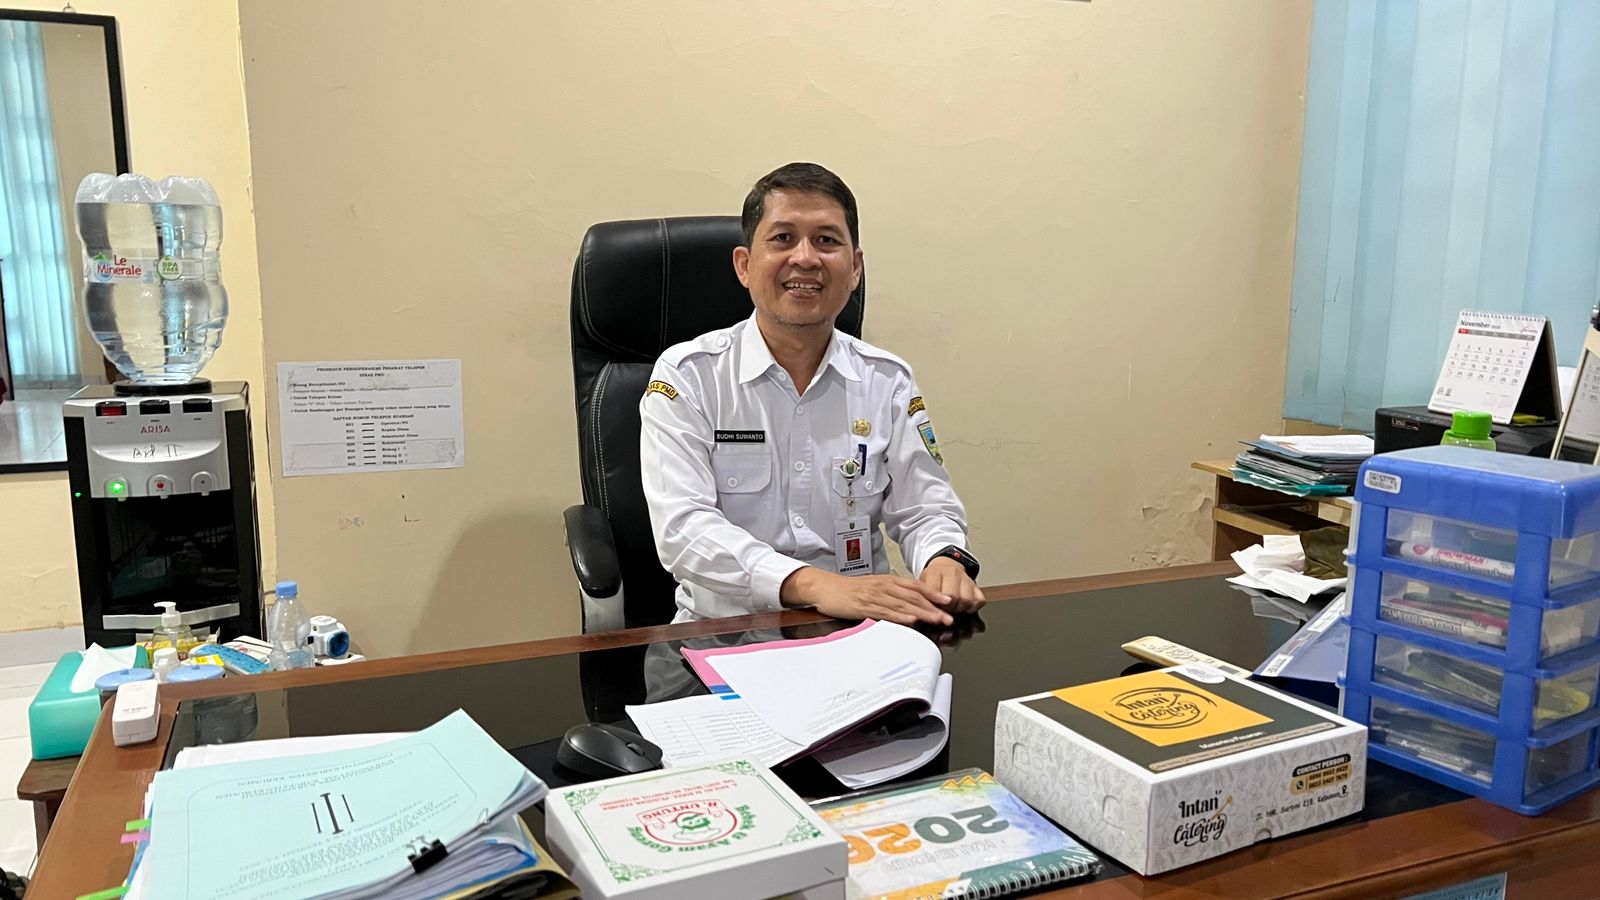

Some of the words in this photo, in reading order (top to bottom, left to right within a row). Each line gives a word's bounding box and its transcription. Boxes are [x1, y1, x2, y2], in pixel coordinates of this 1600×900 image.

[113, 254, 127, 266] Le
[97, 263, 142, 276] Minerale
[1460, 320, 1490, 328] November
[660, 384, 676, 396] PMD
[140, 425, 171, 434] ARISA
[1116, 692, 1170, 710] Intan
[1130, 700, 1200, 723] Catering
[1296, 762, 1321, 775] CONTACT
[1321, 757, 1343, 768] PERSON
[642, 802, 700, 820] UNTUNG
[1178, 792, 1221, 818] Intan
[1173, 814, 1228, 847] Catering
